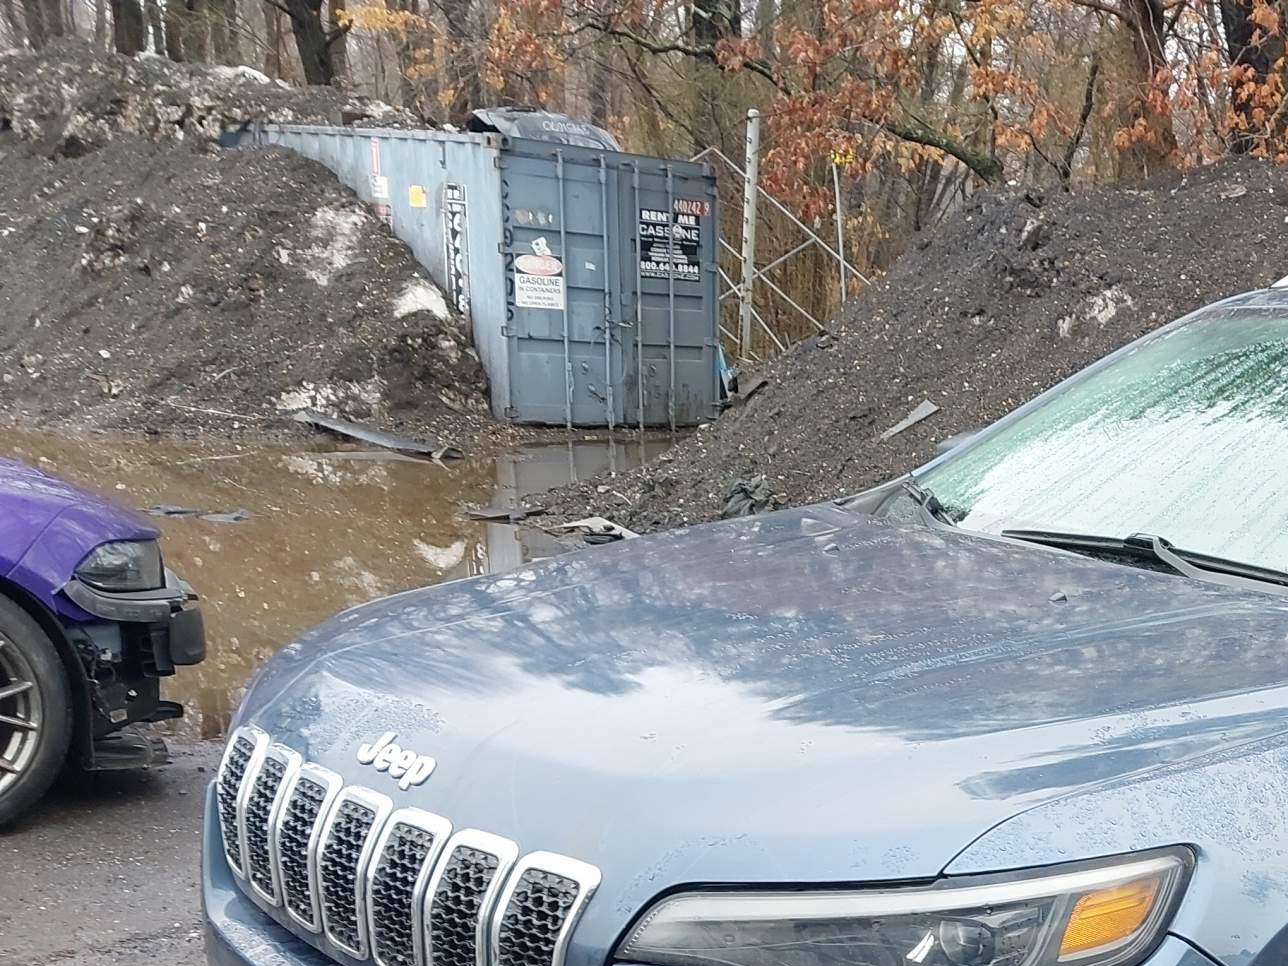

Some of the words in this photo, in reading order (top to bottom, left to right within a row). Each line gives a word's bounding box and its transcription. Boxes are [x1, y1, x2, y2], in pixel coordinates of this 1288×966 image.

[677, 214, 696, 225] ME
[519, 275, 560, 287] GASOLINE
[525, 286, 561, 294] CONTAINERS
[357, 731, 438, 791] Jeep
